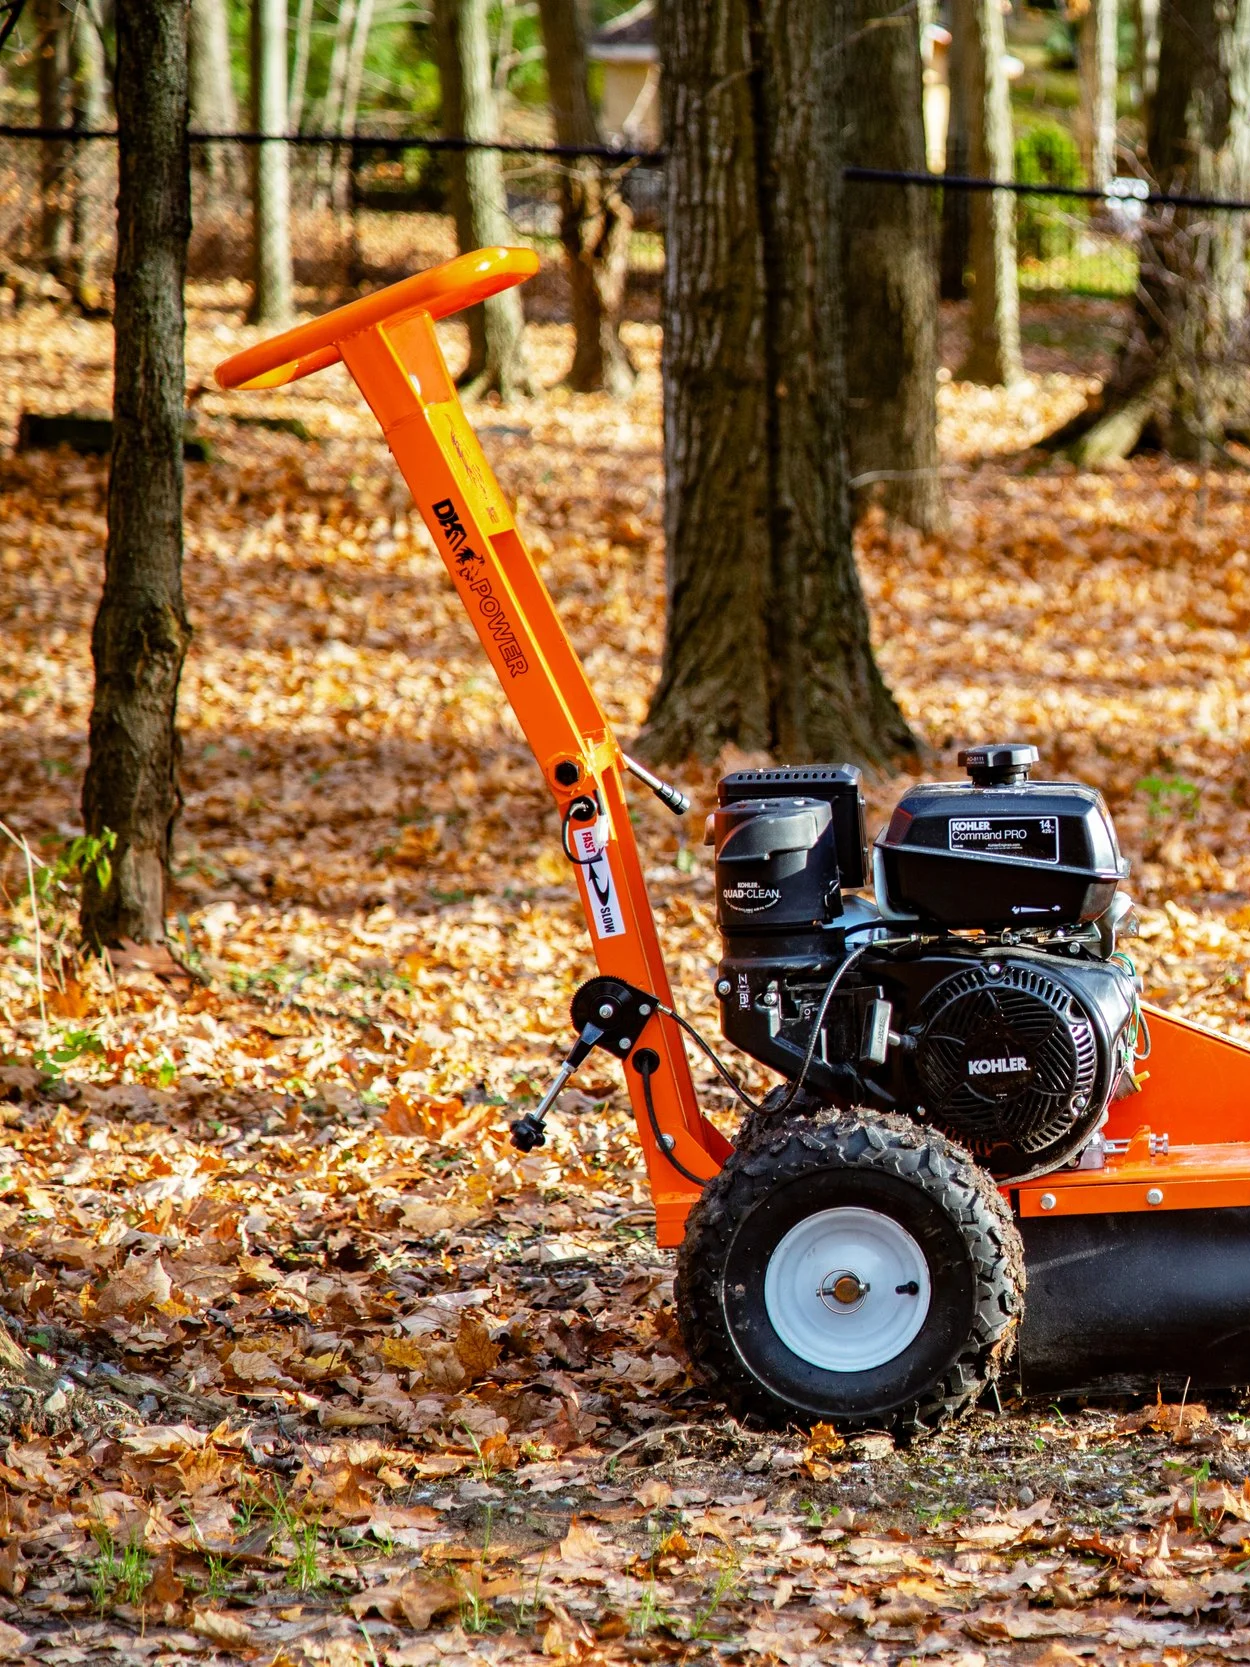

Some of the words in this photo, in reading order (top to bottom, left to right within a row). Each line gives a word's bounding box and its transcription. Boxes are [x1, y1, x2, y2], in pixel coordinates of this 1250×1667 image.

[470, 578, 529, 678] POWER
[951, 821, 991, 831] KOHLER
[1039, 820, 1051, 829] 14
[581, 831, 597, 854] FAST
[951, 830, 1002, 841] Command
[1003, 829, 1028, 840] PRO
[737, 881, 760, 889] KOHLER
[722, 889, 781, 899] QUAD-CLEAN
[600, 906, 616, 933] SLOW
[875, 1017, 886, 1046] START
[968, 1057, 1028, 1075] KOHLER
